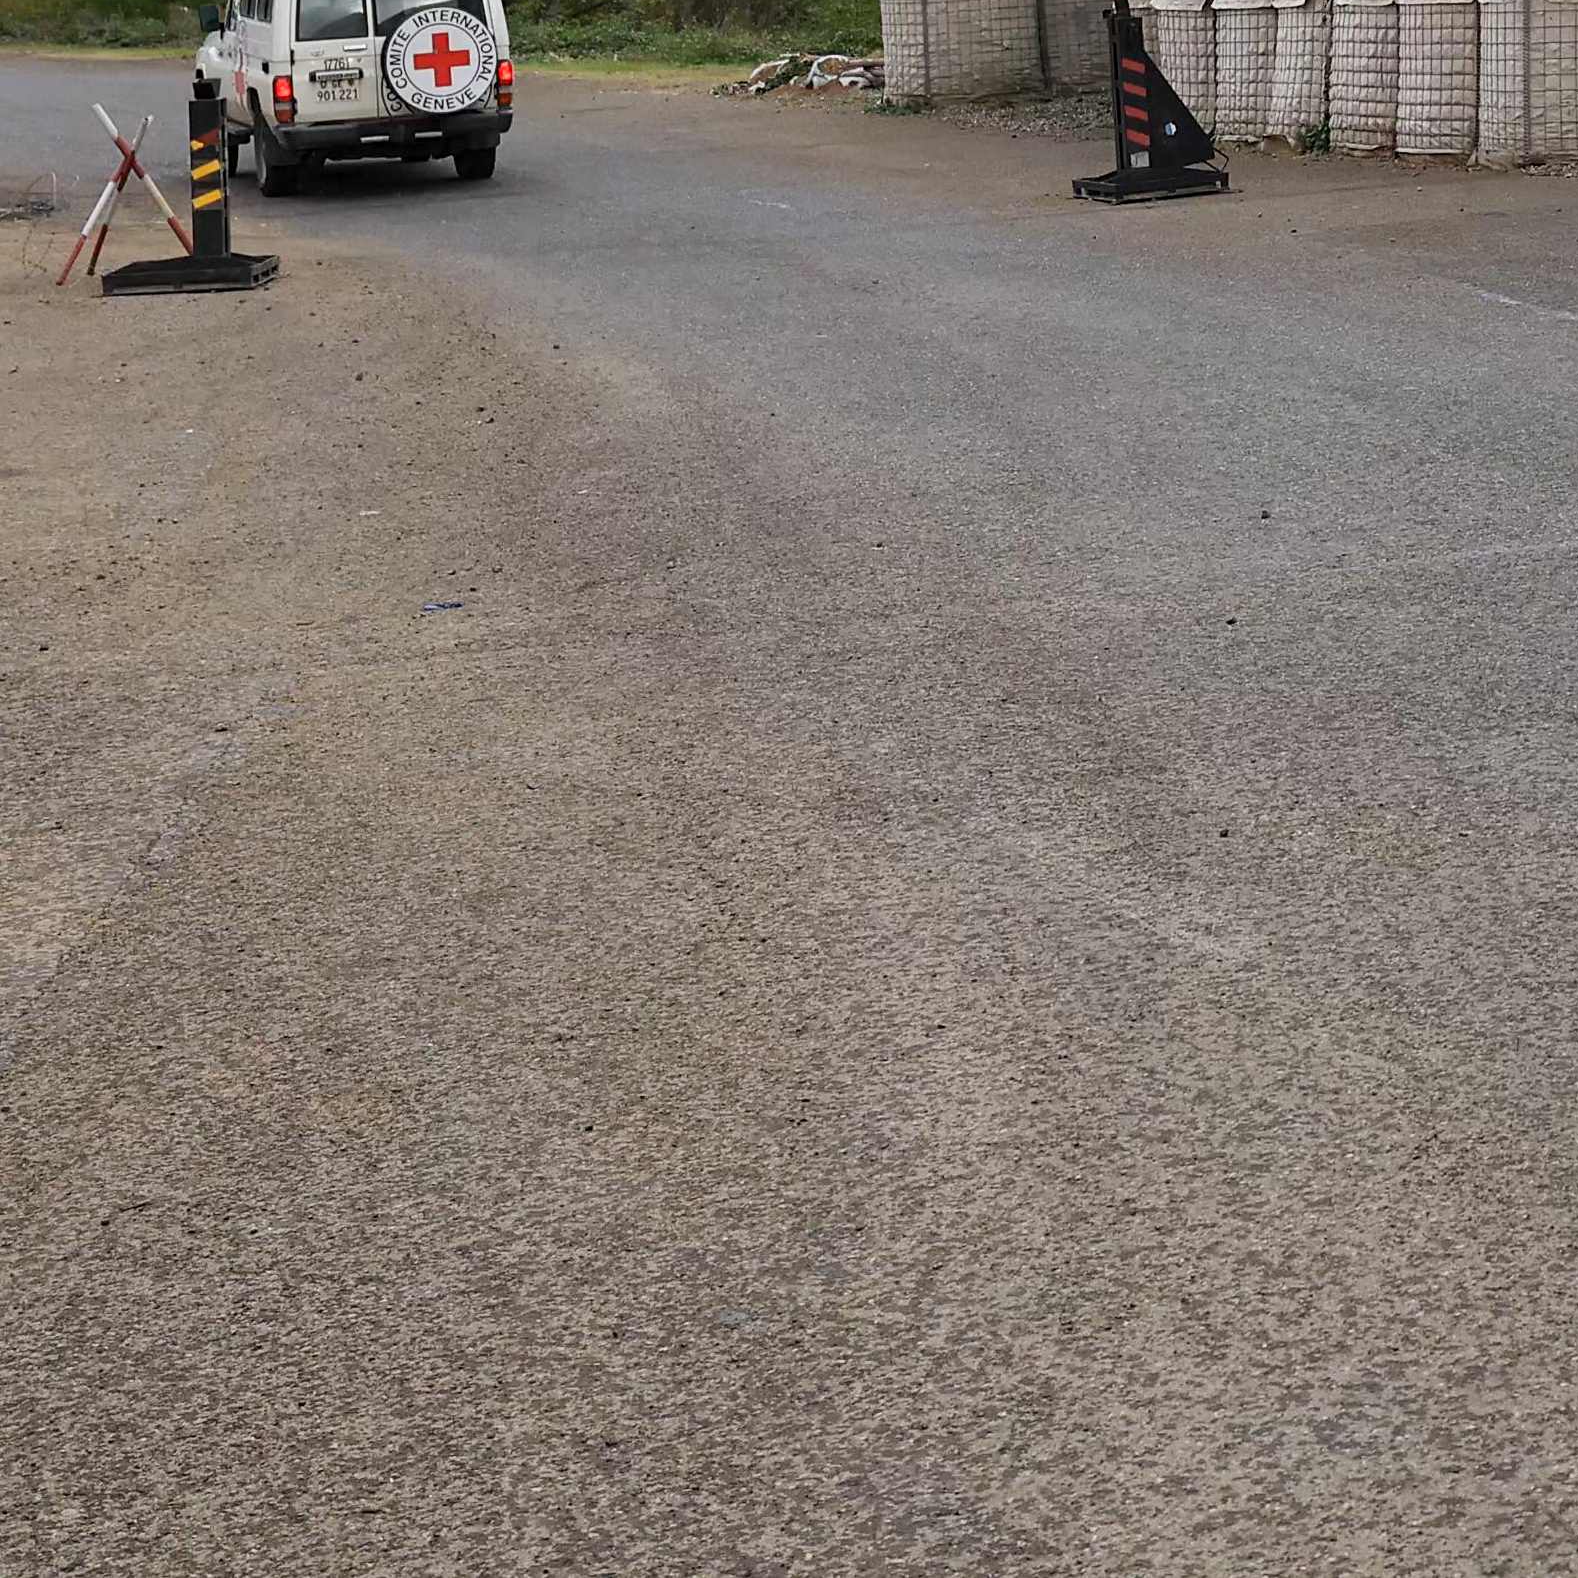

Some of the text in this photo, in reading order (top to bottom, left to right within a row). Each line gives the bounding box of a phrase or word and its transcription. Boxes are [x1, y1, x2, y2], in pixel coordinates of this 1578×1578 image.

[388, 10, 494, 89] COMITE INTERNATIONAL
[411, 87, 477, 110] GENEVE
